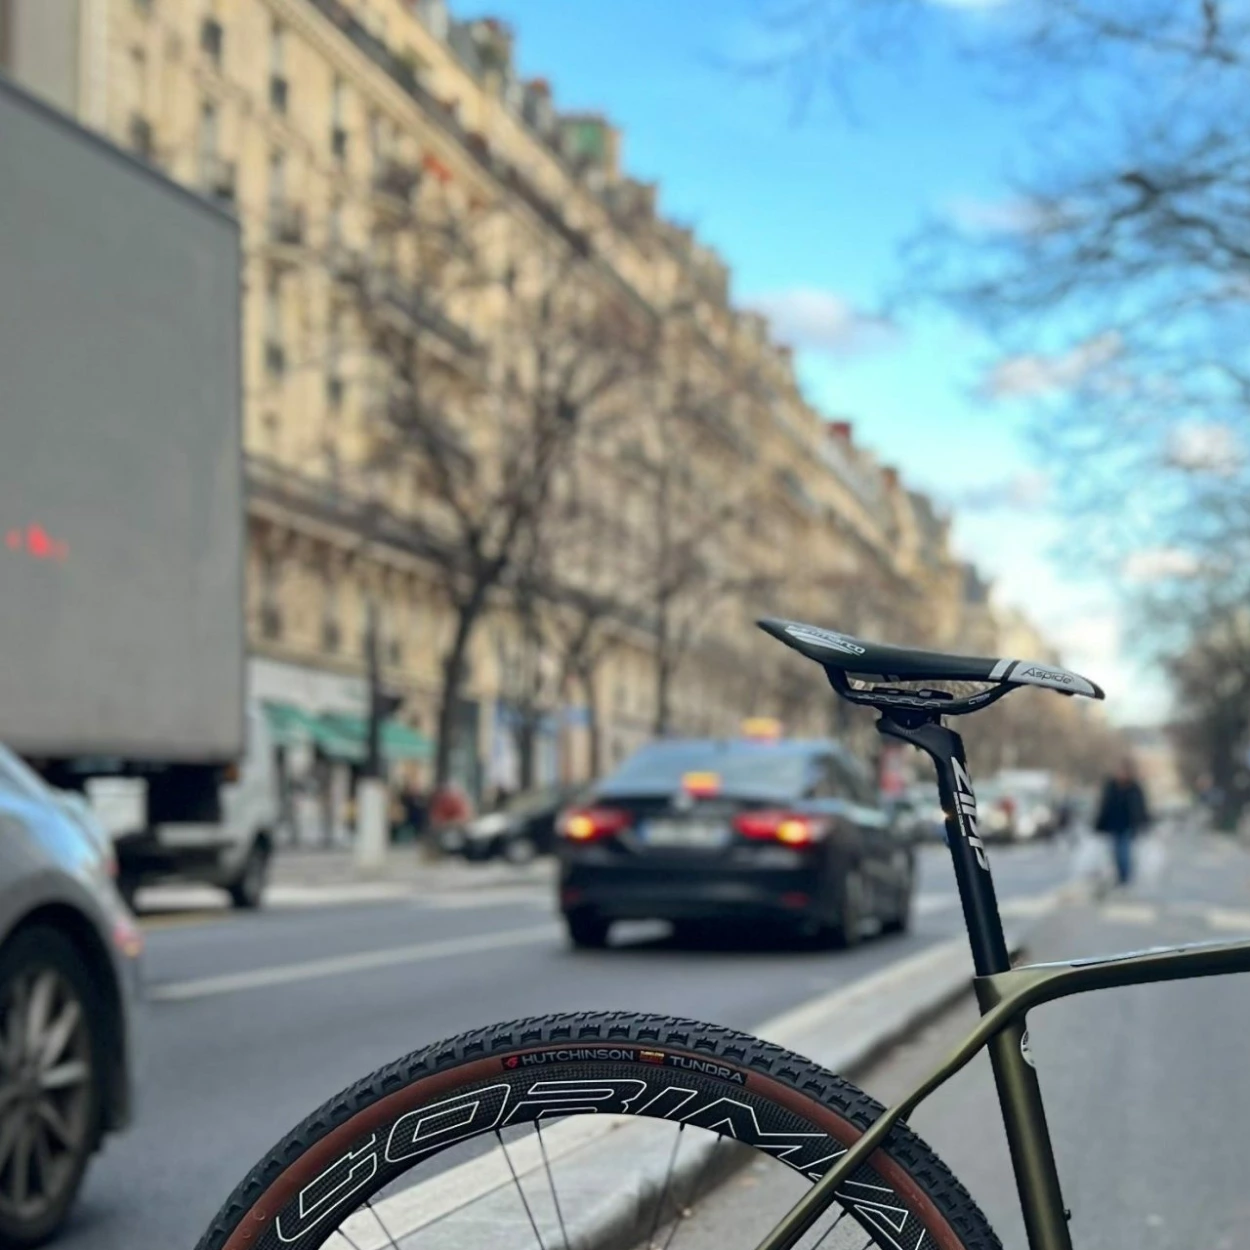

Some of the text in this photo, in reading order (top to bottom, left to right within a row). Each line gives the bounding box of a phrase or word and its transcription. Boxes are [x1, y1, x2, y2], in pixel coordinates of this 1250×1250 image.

[1021, 667, 1073, 684] Aspide
[951, 756, 990, 871] ZIPP
[522, 1049, 634, 1065] HUTCHINSON
[669, 1054, 743, 1084] TUNDRA
